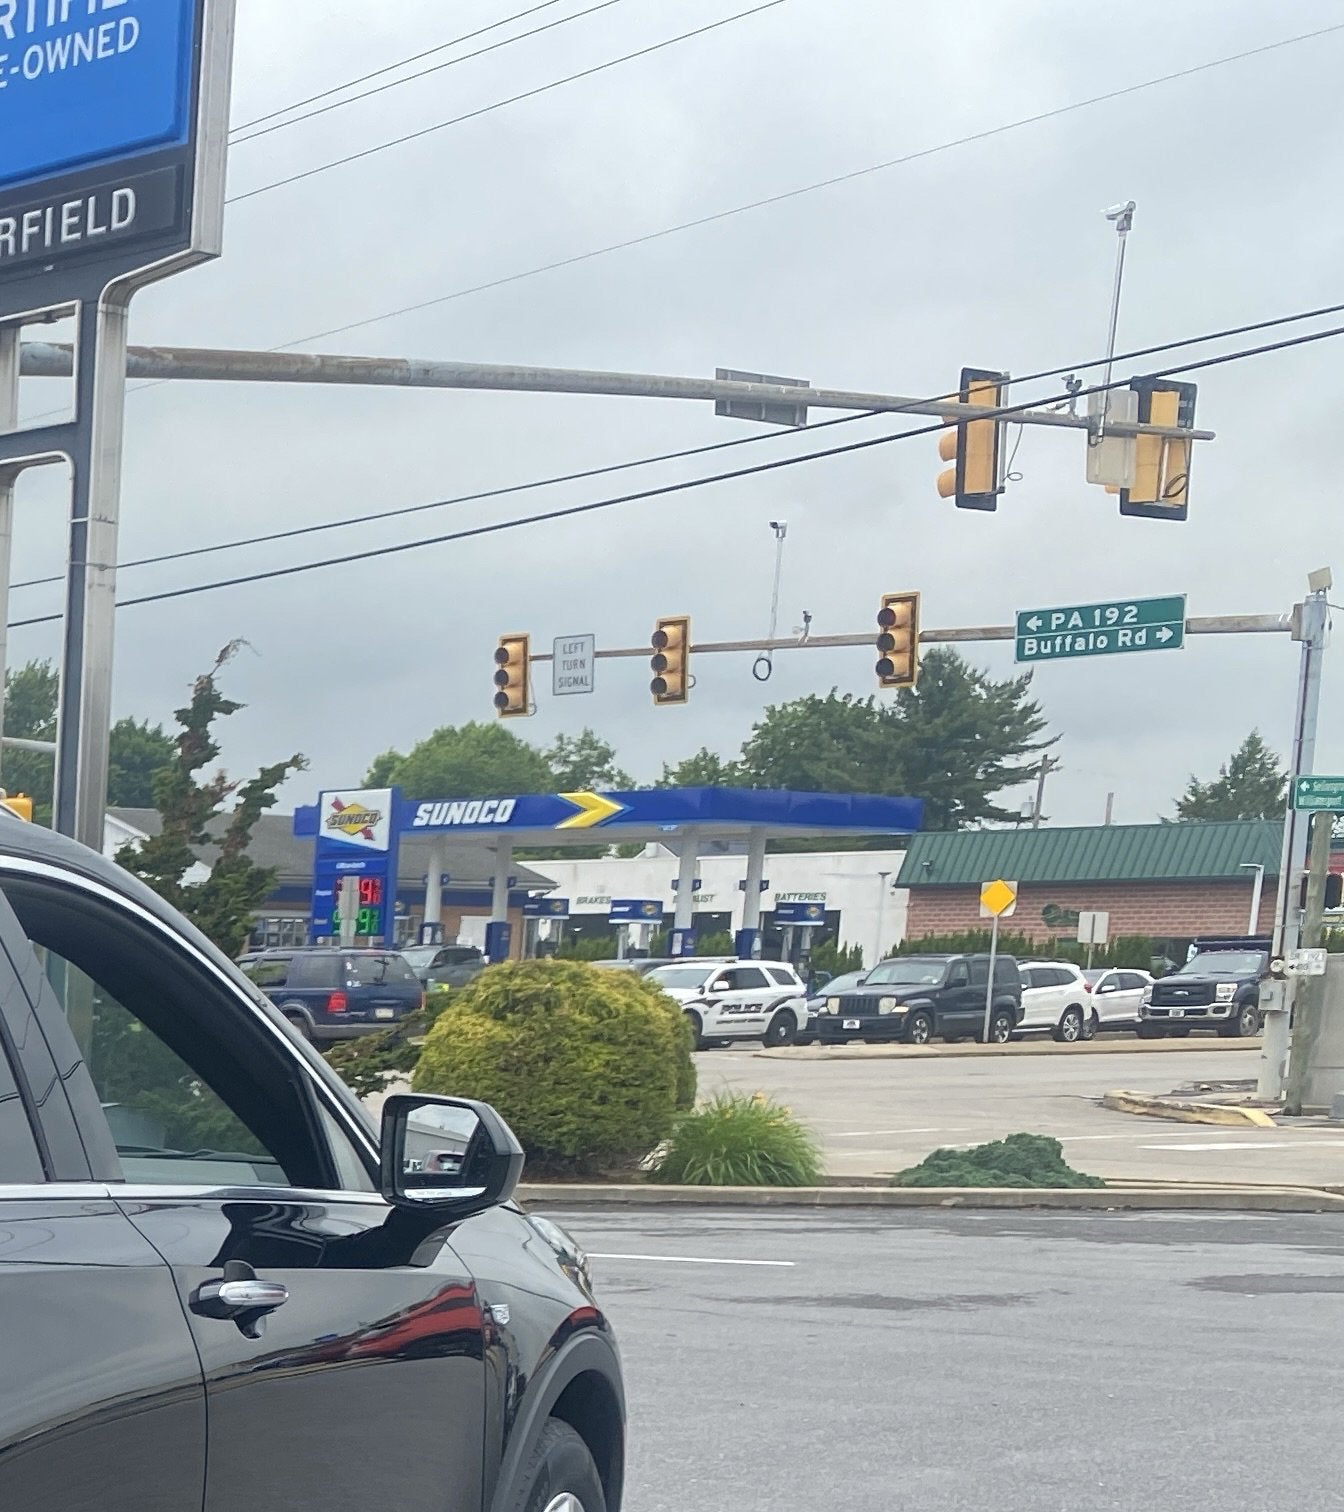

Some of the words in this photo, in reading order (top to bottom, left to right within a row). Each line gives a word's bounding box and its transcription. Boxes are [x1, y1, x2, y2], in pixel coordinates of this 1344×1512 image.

[1050, 611, 1083, 630] PA
[1094, 605, 1138, 626] 192
[562, 642, 584, 655] LEFT
[1024, 633, 1108, 656] Buffalo
[1117, 628, 1147, 647] Rd
[562, 659, 586, 671] TURN
[558, 675, 591, 689] SIGNAL
[329, 812, 378, 827] SUNOCO
[413, 799, 516, 827] SUNOCO
[576, 896, 611, 905] BRAKES
[774, 891, 826, 901] BATTERIES
